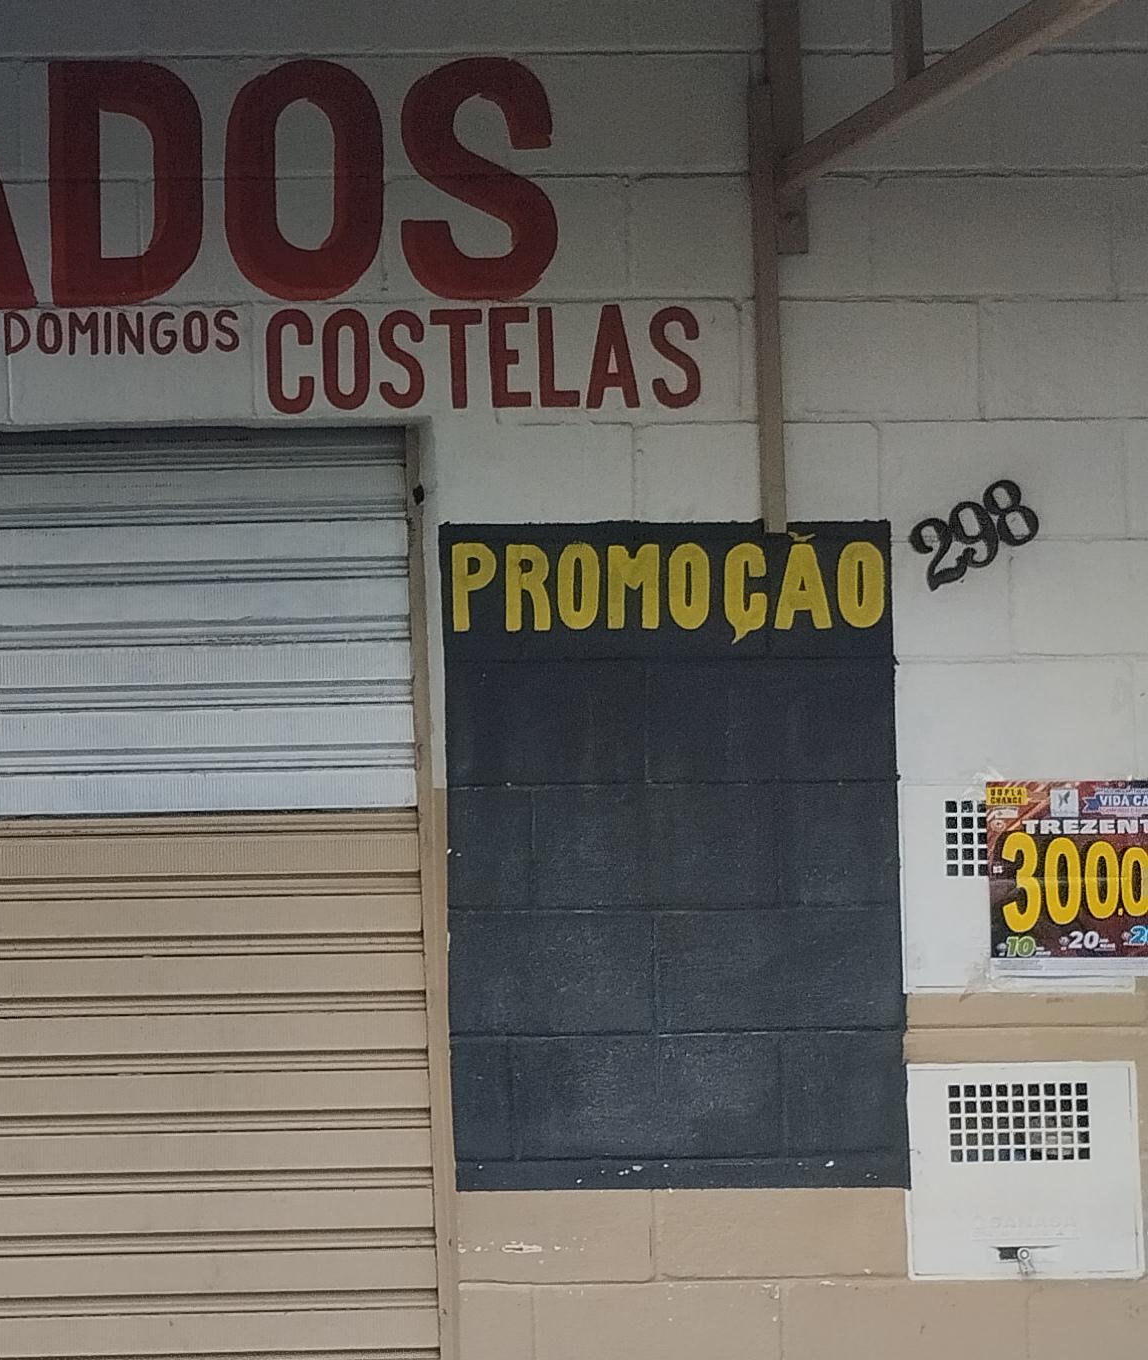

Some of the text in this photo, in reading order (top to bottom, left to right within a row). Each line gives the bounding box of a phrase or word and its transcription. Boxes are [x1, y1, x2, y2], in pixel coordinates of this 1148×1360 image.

[4, 309, 241, 357] DOMINGOS
[265, 304, 701, 415] COSTELAS
[451, 532, 885, 645] PROMOÇÃO
[908, 478, 1040, 592] 298
[1099, 794, 1130, 807] VIDA
